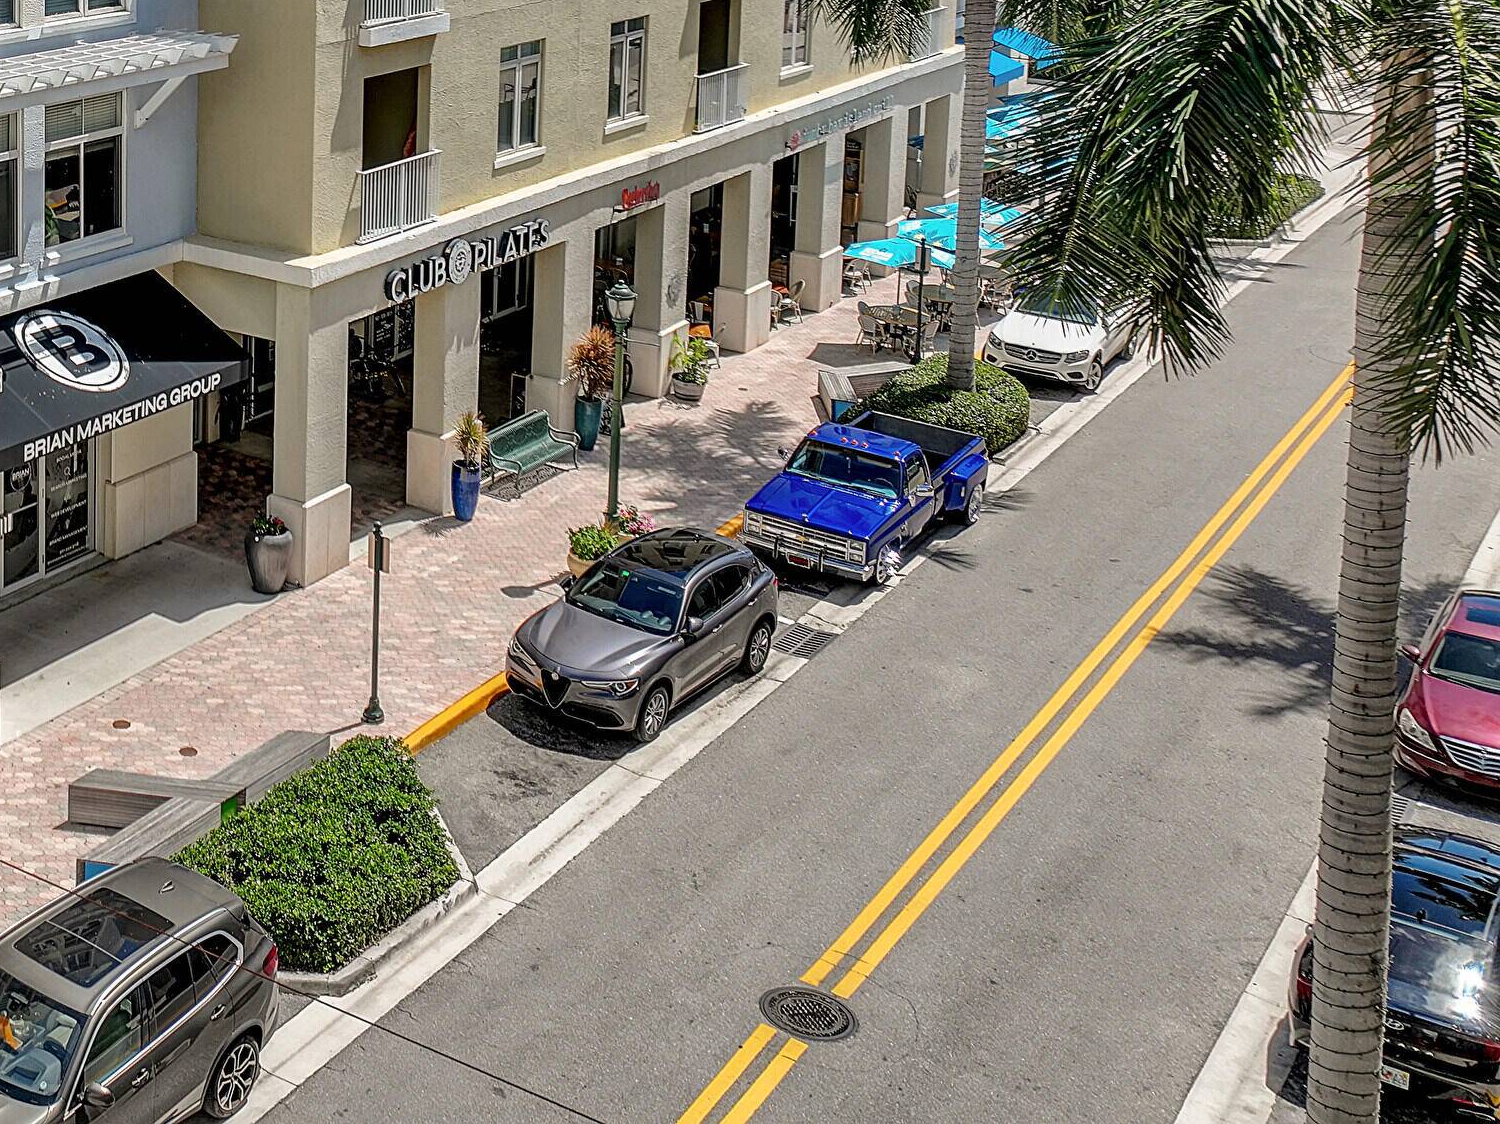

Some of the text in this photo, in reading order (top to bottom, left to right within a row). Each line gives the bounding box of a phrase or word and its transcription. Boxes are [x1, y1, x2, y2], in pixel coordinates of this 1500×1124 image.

[384, 218, 550, 303] CLUB PILATES
[23, 373, 221, 463] BRIAN MARKETING GROUP
